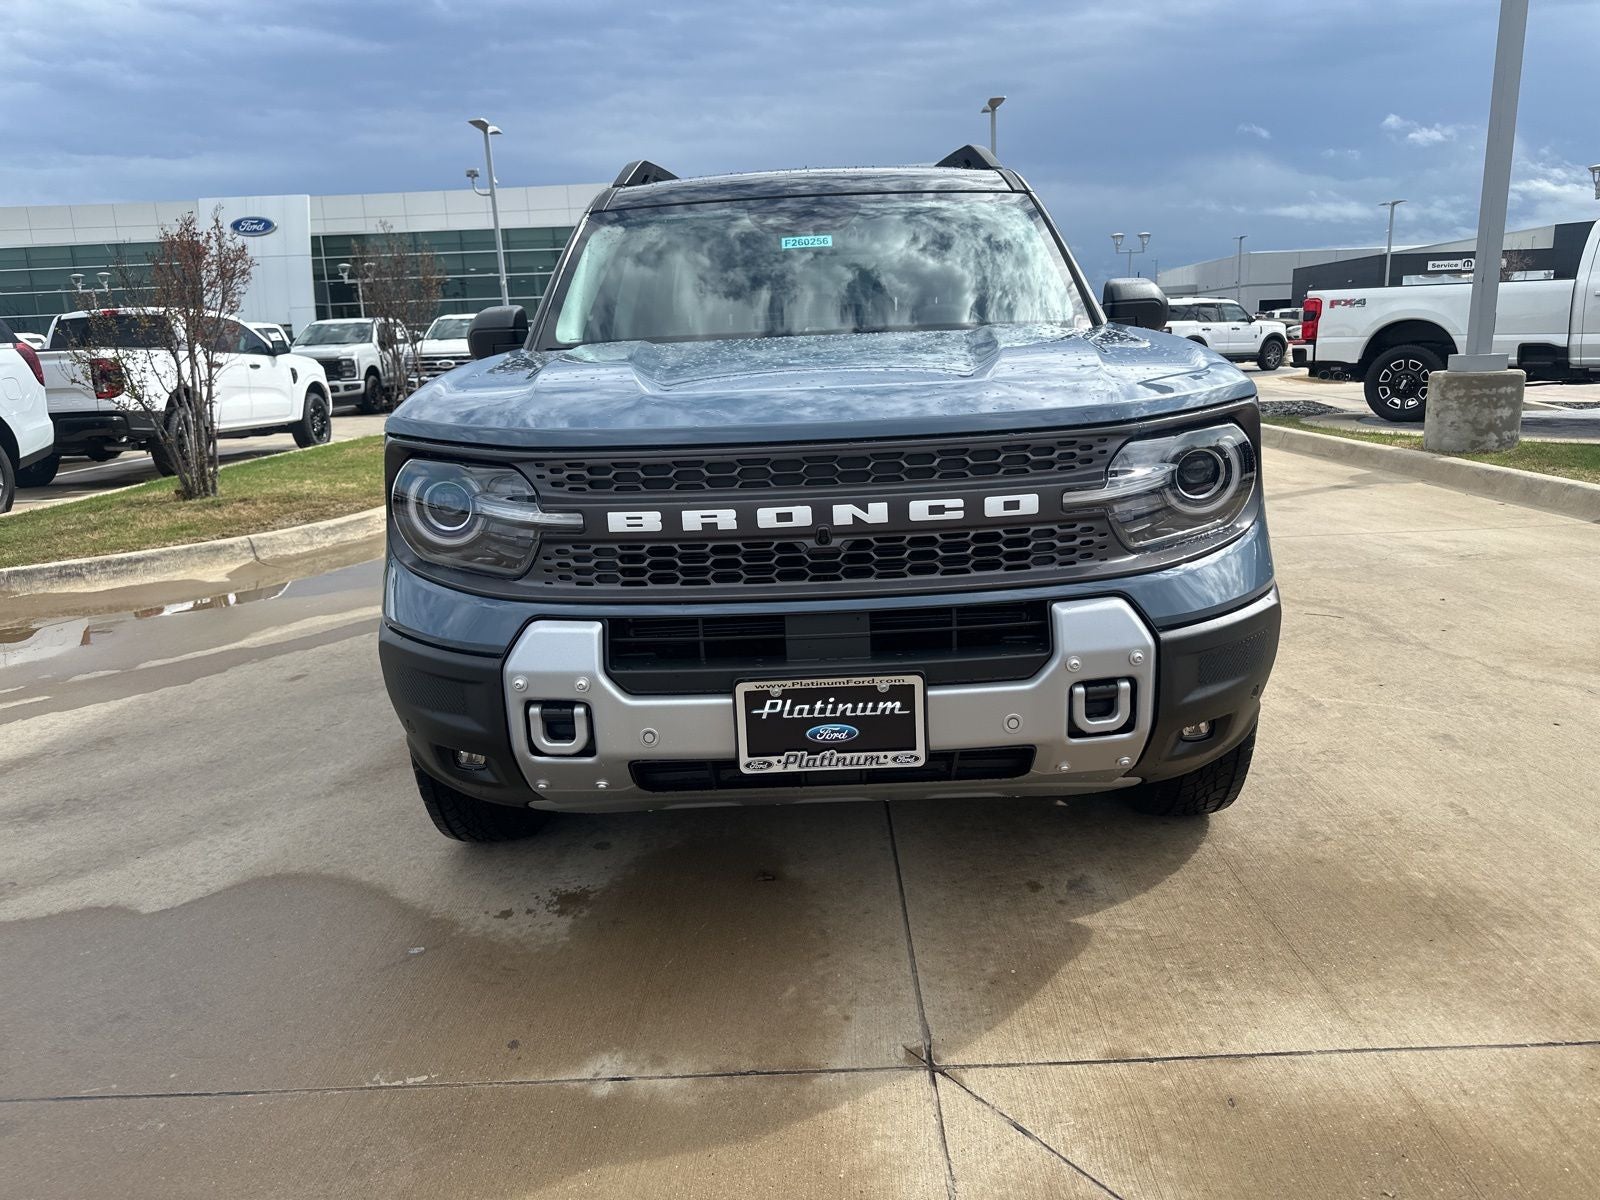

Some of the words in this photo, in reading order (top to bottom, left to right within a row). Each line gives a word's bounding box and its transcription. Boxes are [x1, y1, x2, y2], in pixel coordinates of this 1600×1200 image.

[239, 219, 266, 232] Ford
[784, 237, 829, 247] F260256
[1329, 298, 1366, 309] FX4
[607, 493, 1040, 533] BRONCO
[754, 677, 905, 690] www.PlatinumFord.com
[751, 697, 911, 720] Platinum
[816, 726, 849, 740] Ford
[749, 759, 769, 770] Ford
[782, 750, 888, 769] Platinum
[896, 753, 916, 764] Ford
